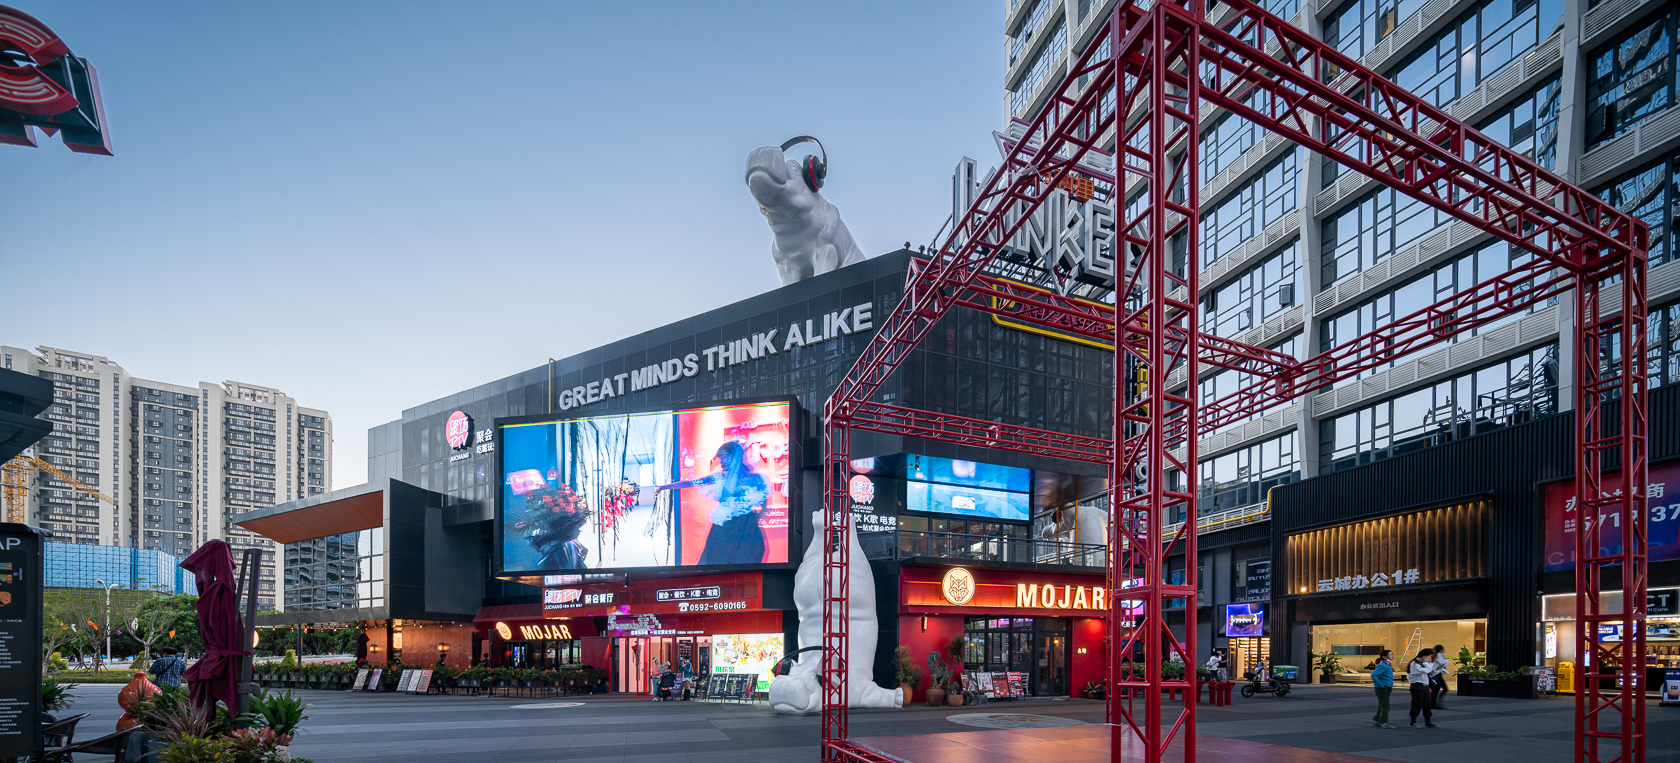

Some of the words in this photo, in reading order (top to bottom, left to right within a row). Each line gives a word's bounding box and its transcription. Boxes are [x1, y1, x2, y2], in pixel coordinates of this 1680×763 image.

[559, 371, 629, 410] GREAT
[631, 353, 699, 392] MINDS
[703, 328, 778, 372] THINK
[783, 301, 874, 351] ALIKE
[476, 428, 493, 444] 聚会
[450, 452, 470, 462] JUCHANG
[863, 514, 879, 524] K歌
[879, 515, 896, 526] 电竞
[1318, 569, 1420, 592] 云城办公1#
[1016, 583, 1105, 610] MOJAR
[1360, 602, 1399, 610] 办公区出入口
[520, 624, 573, 640] MOJAR
